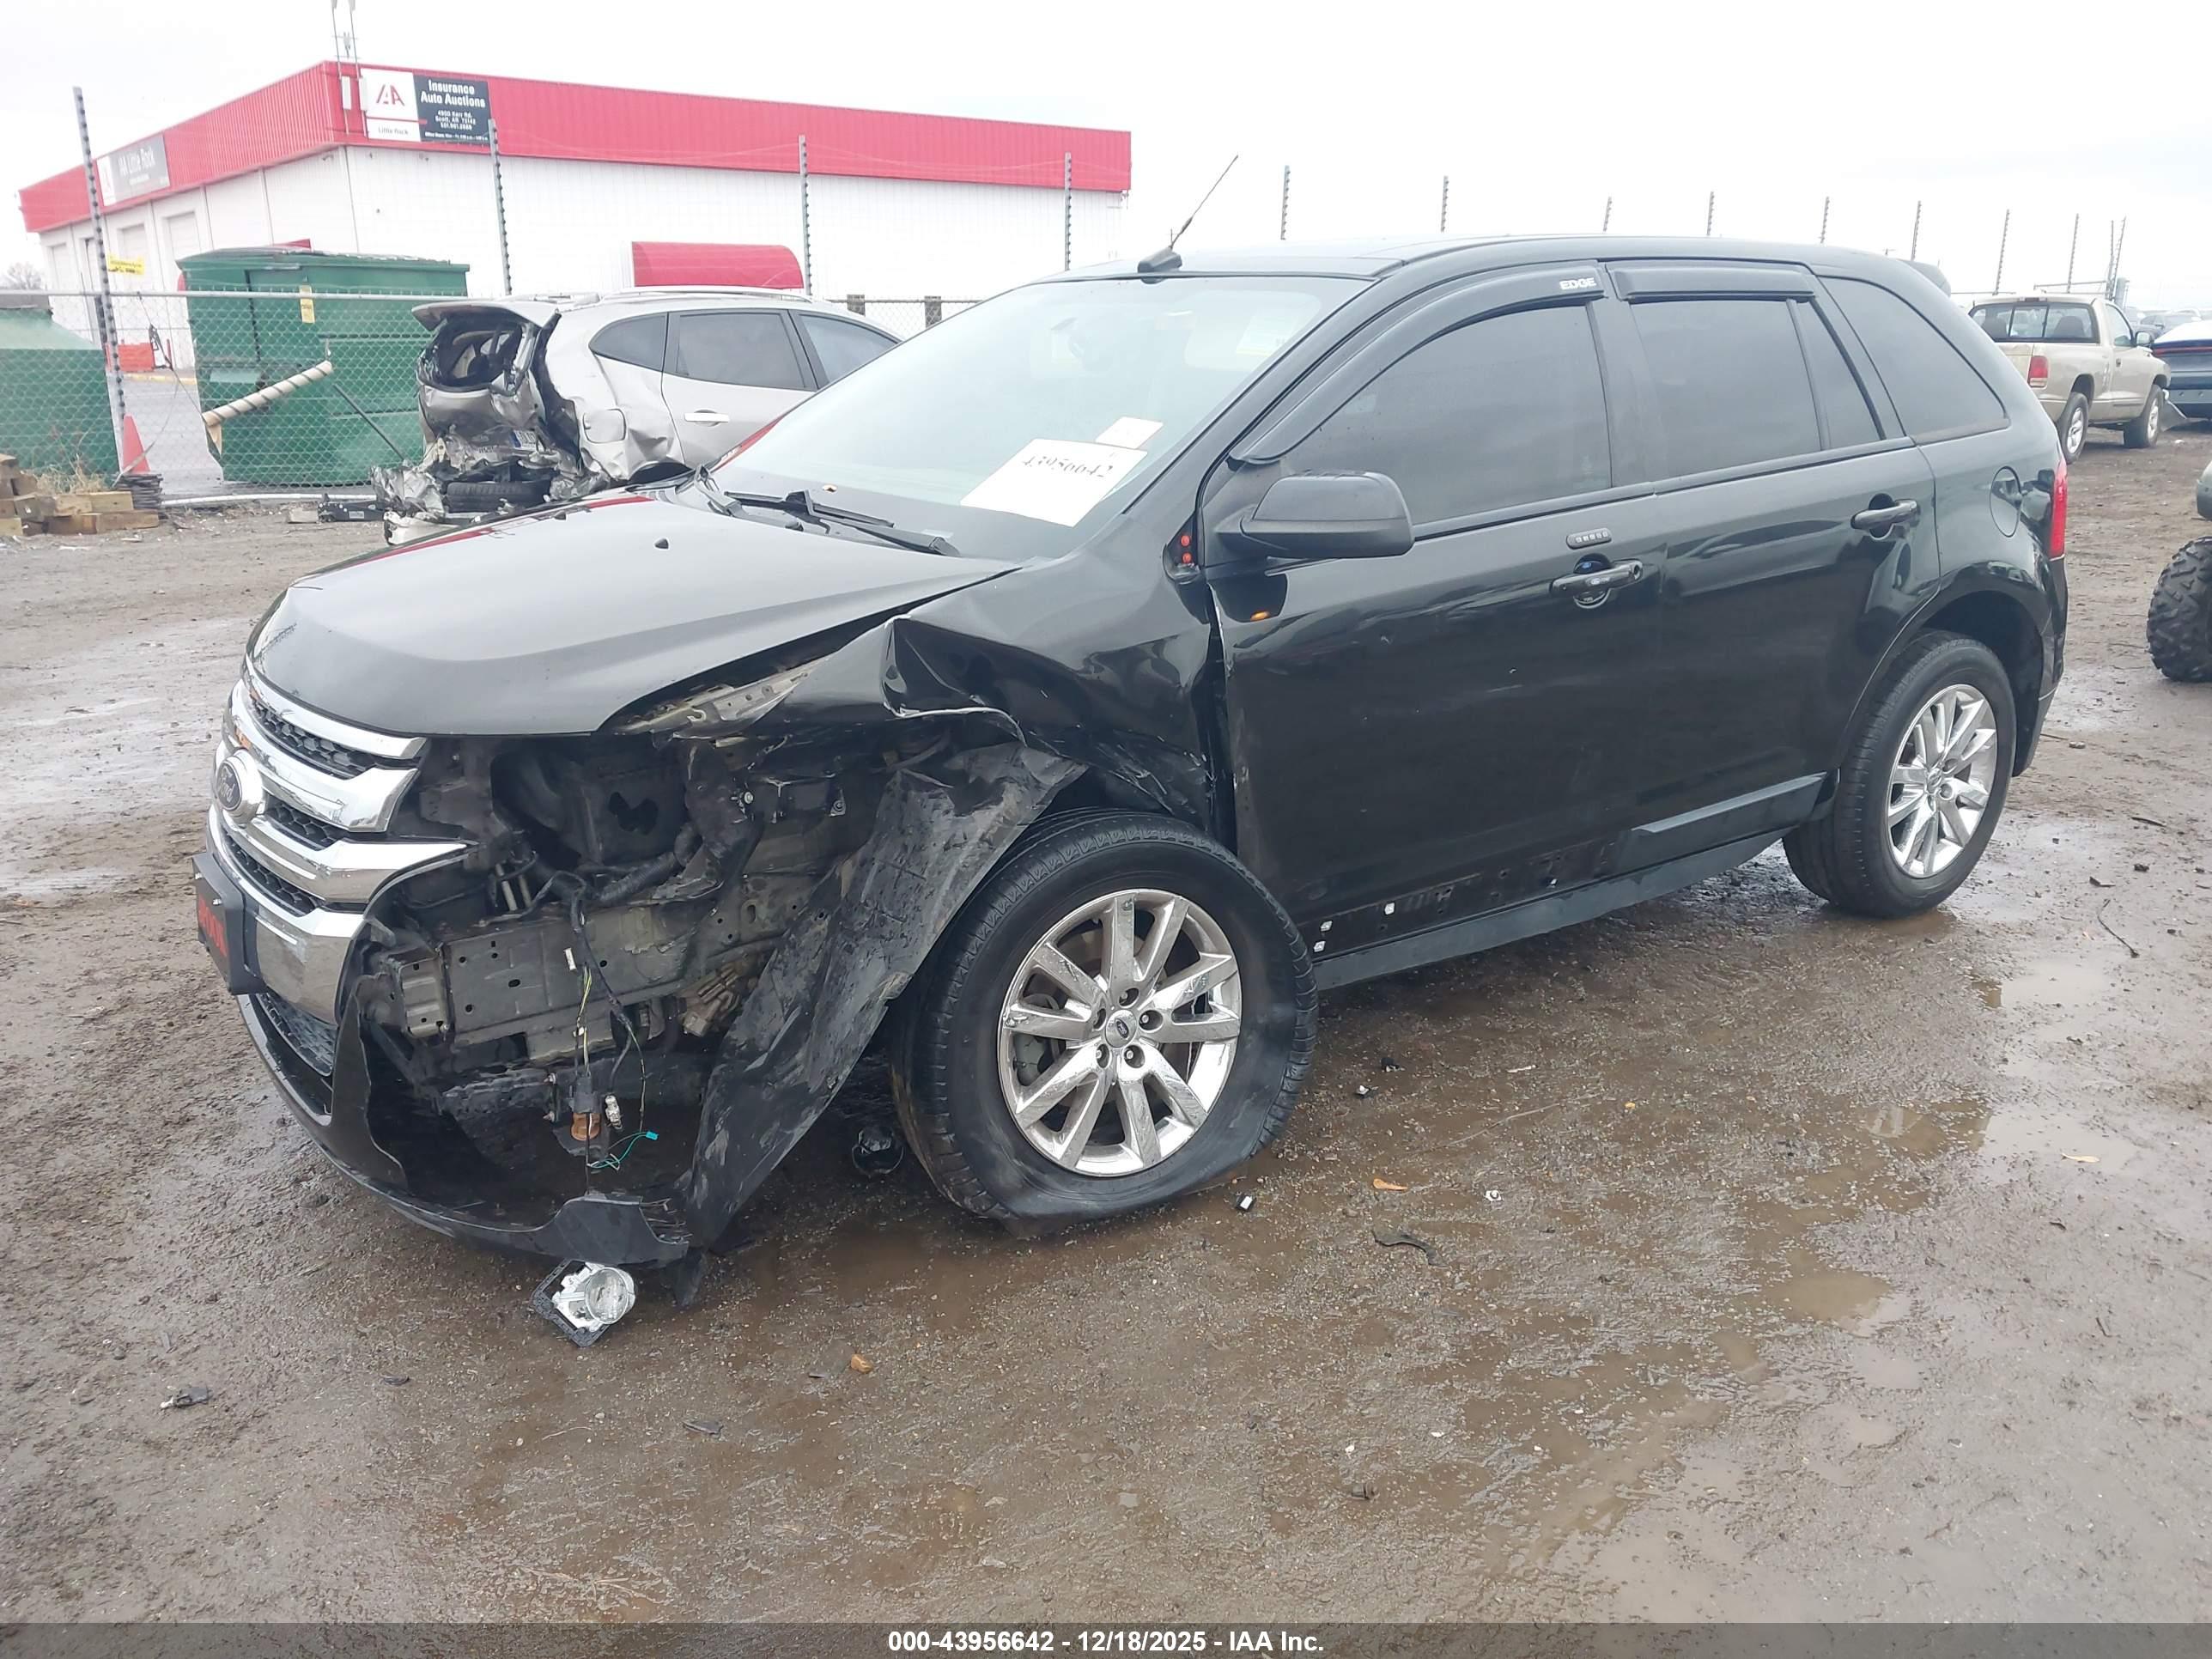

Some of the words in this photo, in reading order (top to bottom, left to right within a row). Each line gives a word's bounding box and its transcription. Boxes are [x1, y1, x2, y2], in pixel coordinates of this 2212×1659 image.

[428, 79, 476, 95] Insurance
[420, 91, 443, 104] Auto
[444, 94, 486, 108] Auctions
[1559, 277, 1597, 290] EDGE
